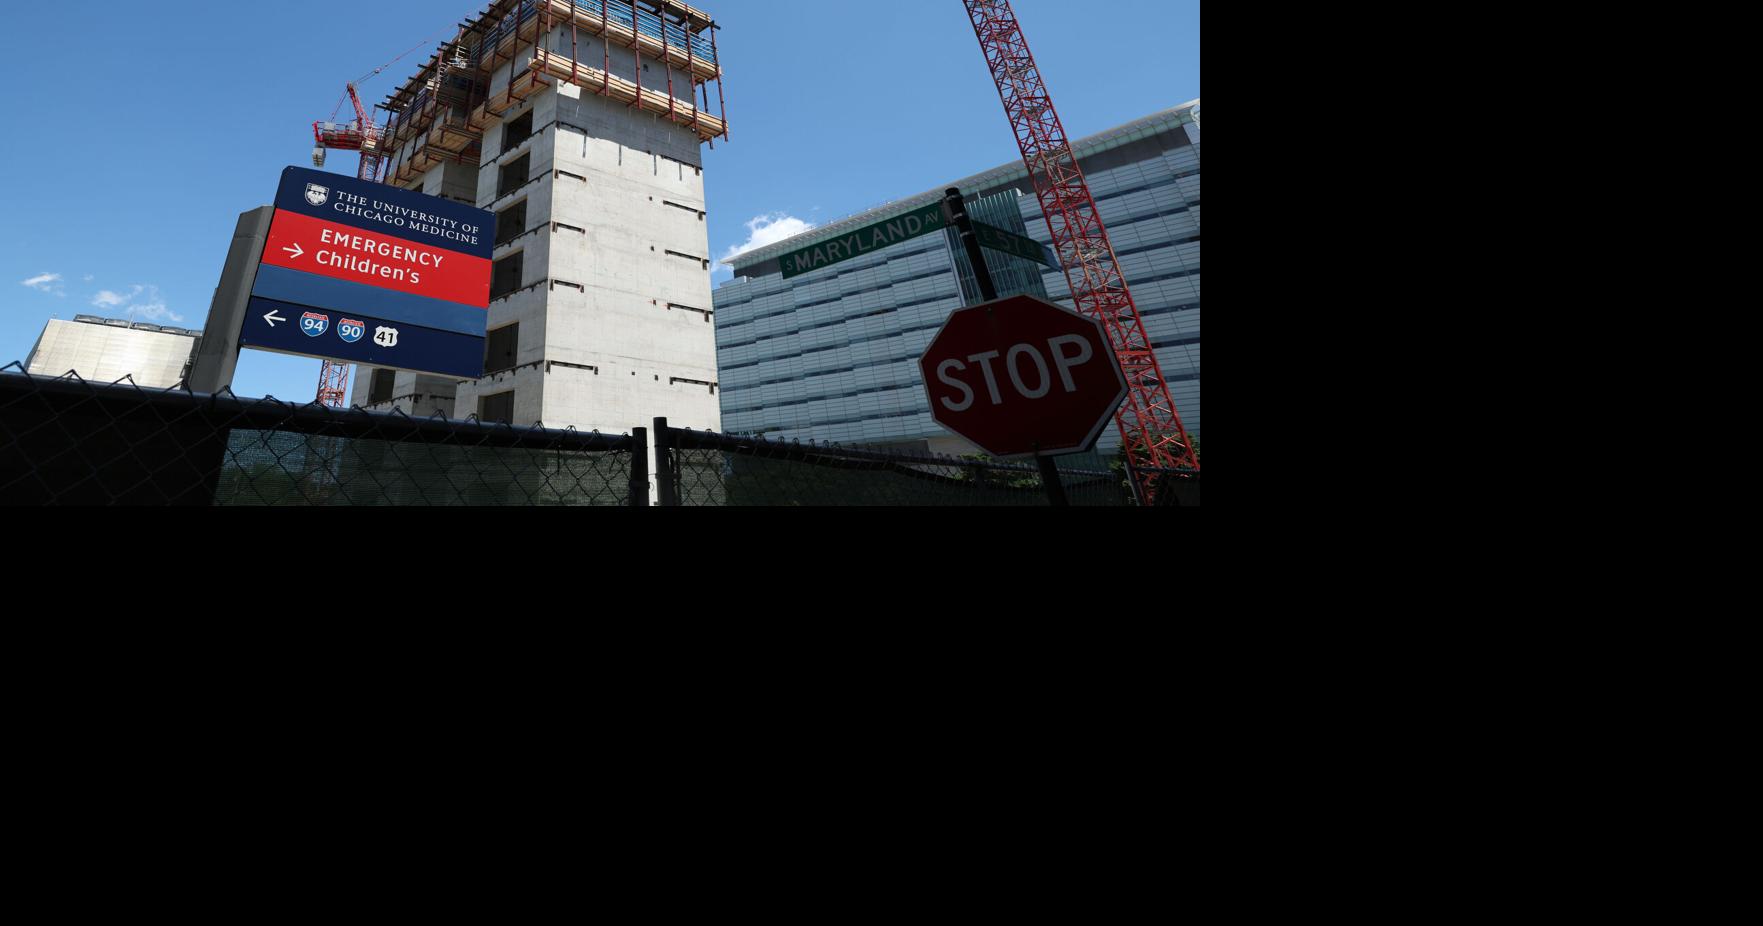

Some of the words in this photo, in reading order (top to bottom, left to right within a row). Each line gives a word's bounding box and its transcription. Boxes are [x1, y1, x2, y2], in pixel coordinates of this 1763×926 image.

[334, 202, 404, 226] CHICAGO
[409, 221, 478, 245] MEDICINE
[336, 190, 367, 205] THE
[373, 200, 458, 229] UNIVERSITY
[461, 223, 479, 234] OF
[320, 228, 443, 268] EMERGENCY
[786, 259, 793, 271] S
[794, 214, 922, 272] MARYLAND
[925, 210, 939, 225] AV
[315, 250, 420, 284] Children's
[304, 318, 324, 332] 94
[341, 325, 361, 338] 90
[376, 331, 394, 344] 41
[936, 332, 1094, 413] STOP
